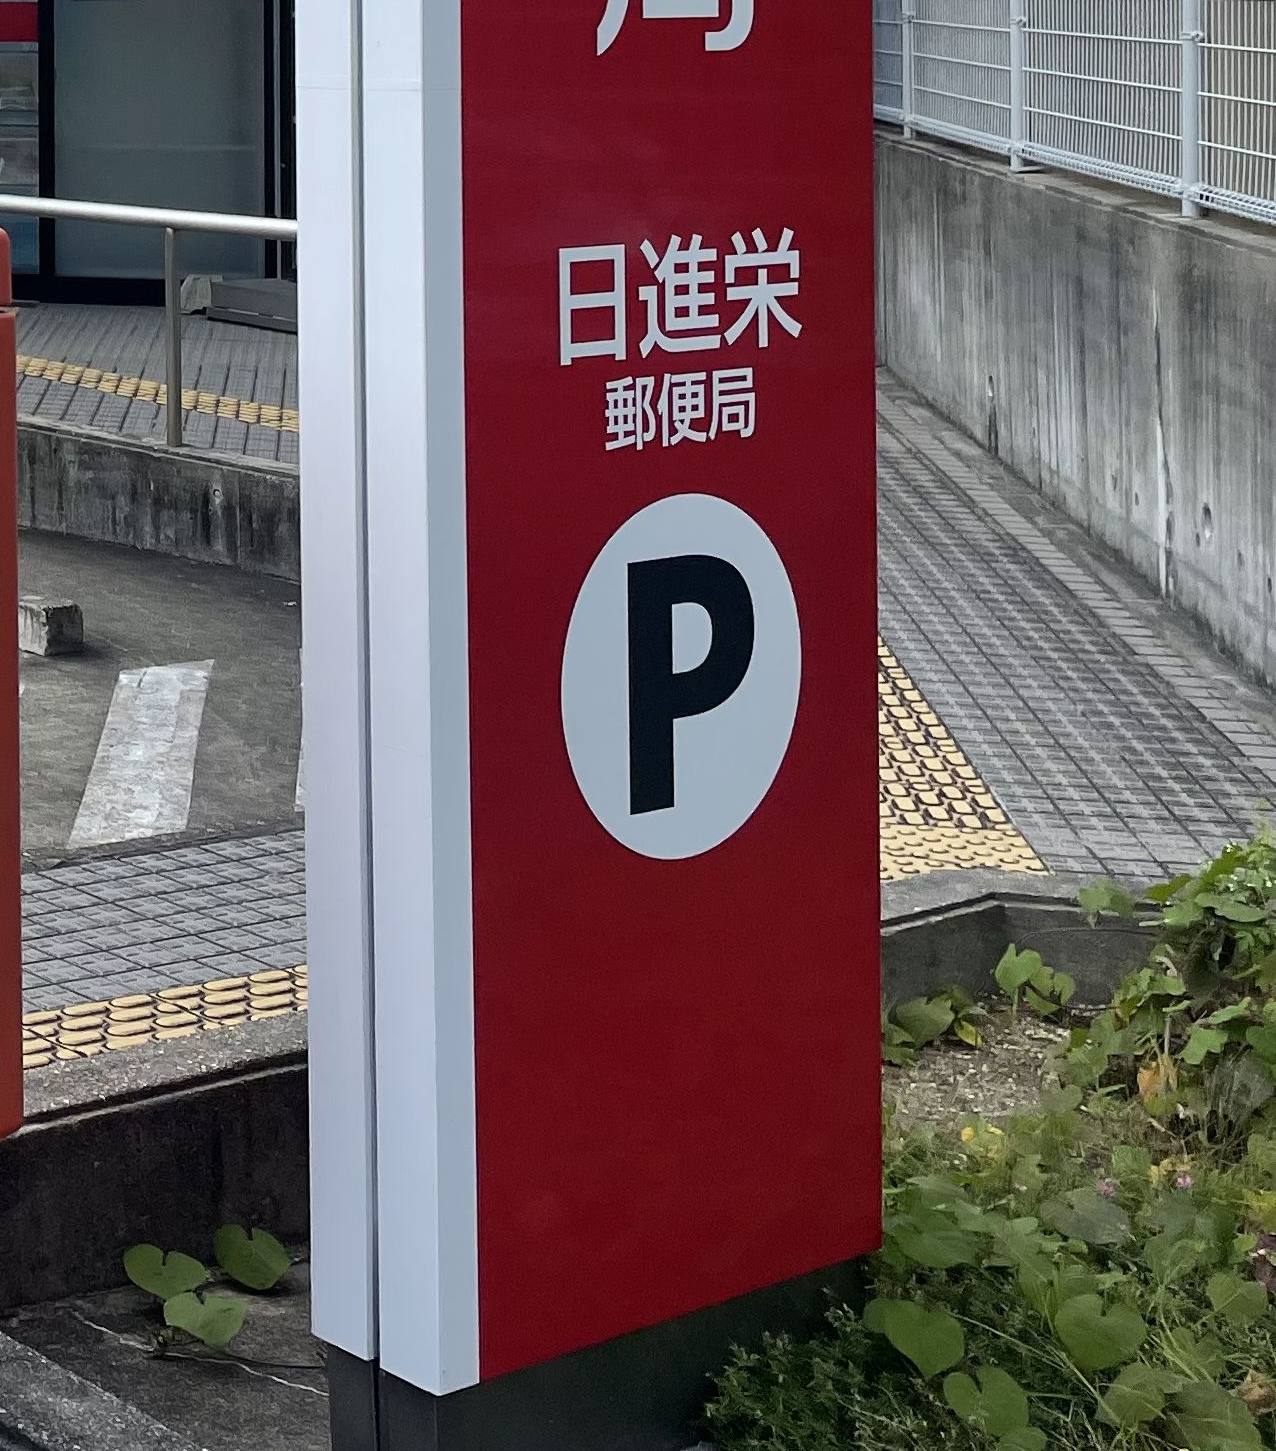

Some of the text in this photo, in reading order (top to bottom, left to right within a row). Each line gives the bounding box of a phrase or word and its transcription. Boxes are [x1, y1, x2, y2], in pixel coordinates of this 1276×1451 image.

[558, 227, 803, 366] 日進栄
[604, 366, 756, 452] 郵便局
[626, 553, 755, 816] P
